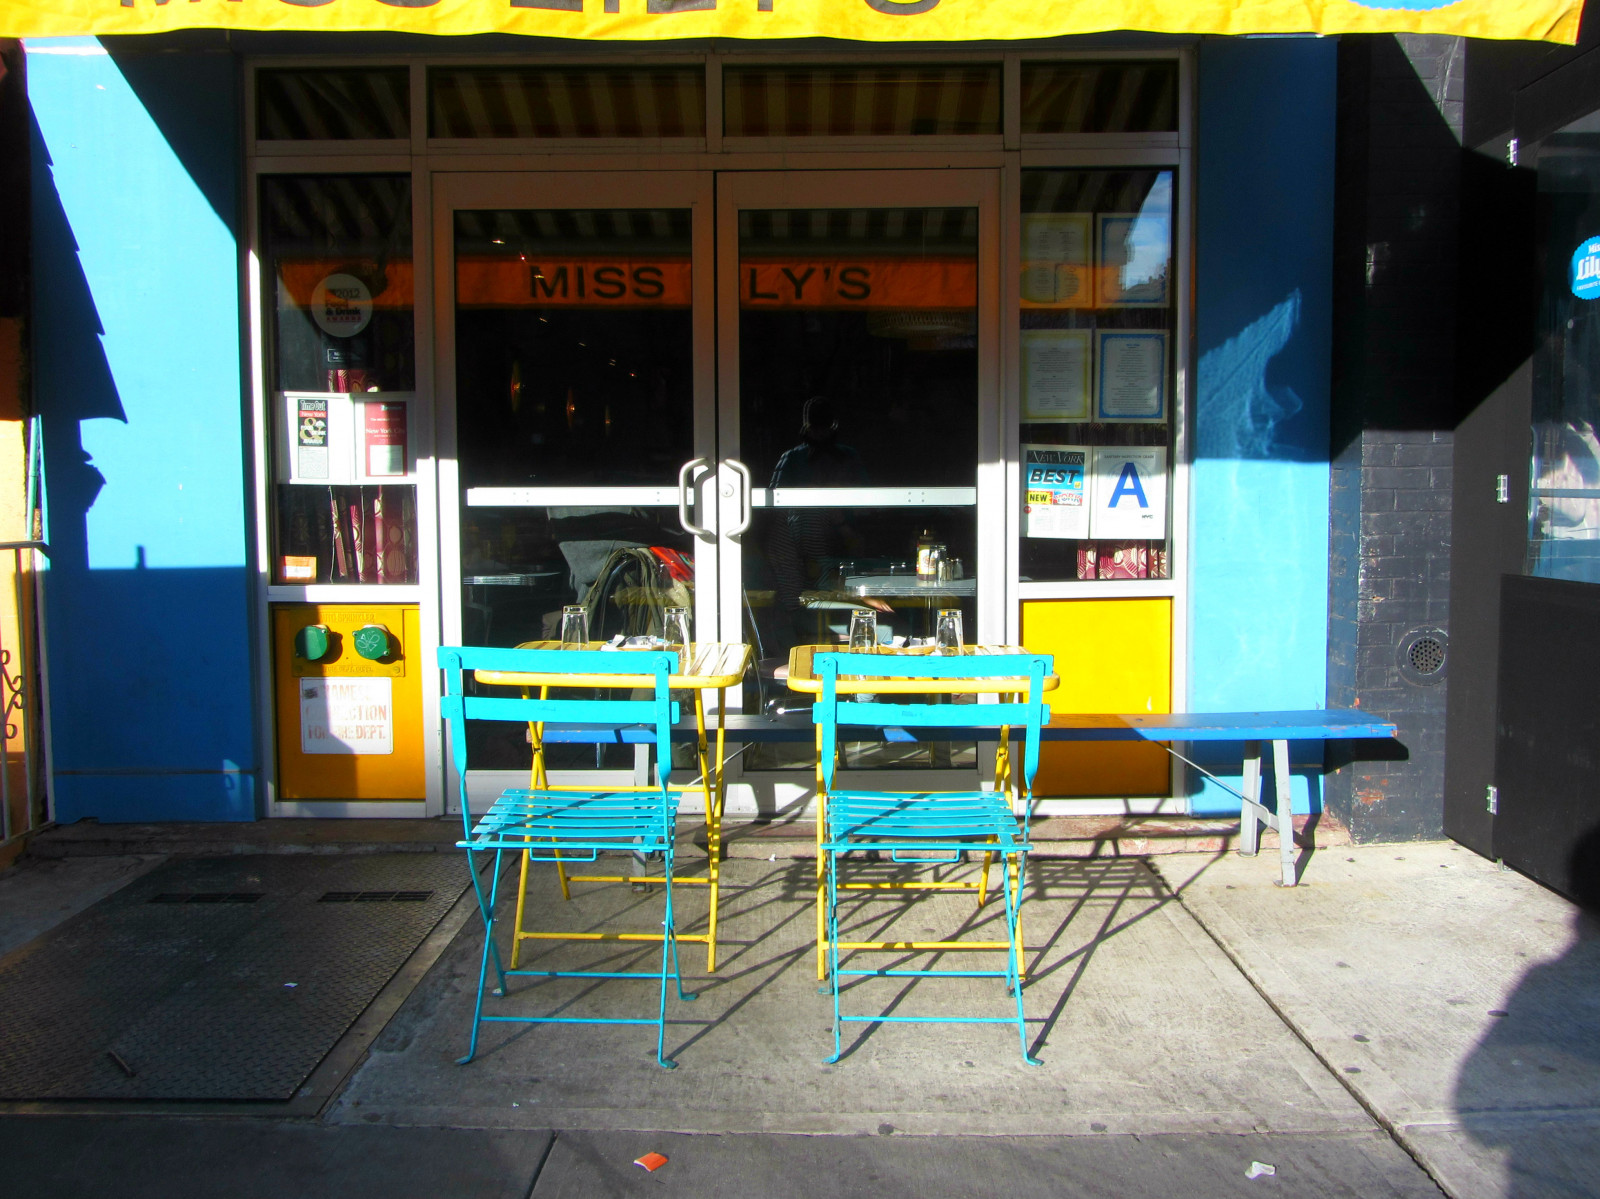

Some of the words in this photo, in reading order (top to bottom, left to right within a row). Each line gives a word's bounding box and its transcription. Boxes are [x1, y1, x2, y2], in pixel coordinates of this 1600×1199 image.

[530, 266, 665, 299] MISS
[335, 288, 360, 298] 2012
[335, 307, 361, 316] Drink
[1030, 468, 1079, 485] BEST
[1107, 462, 1149, 508] A
[1029, 493, 1048, 502] NEW
